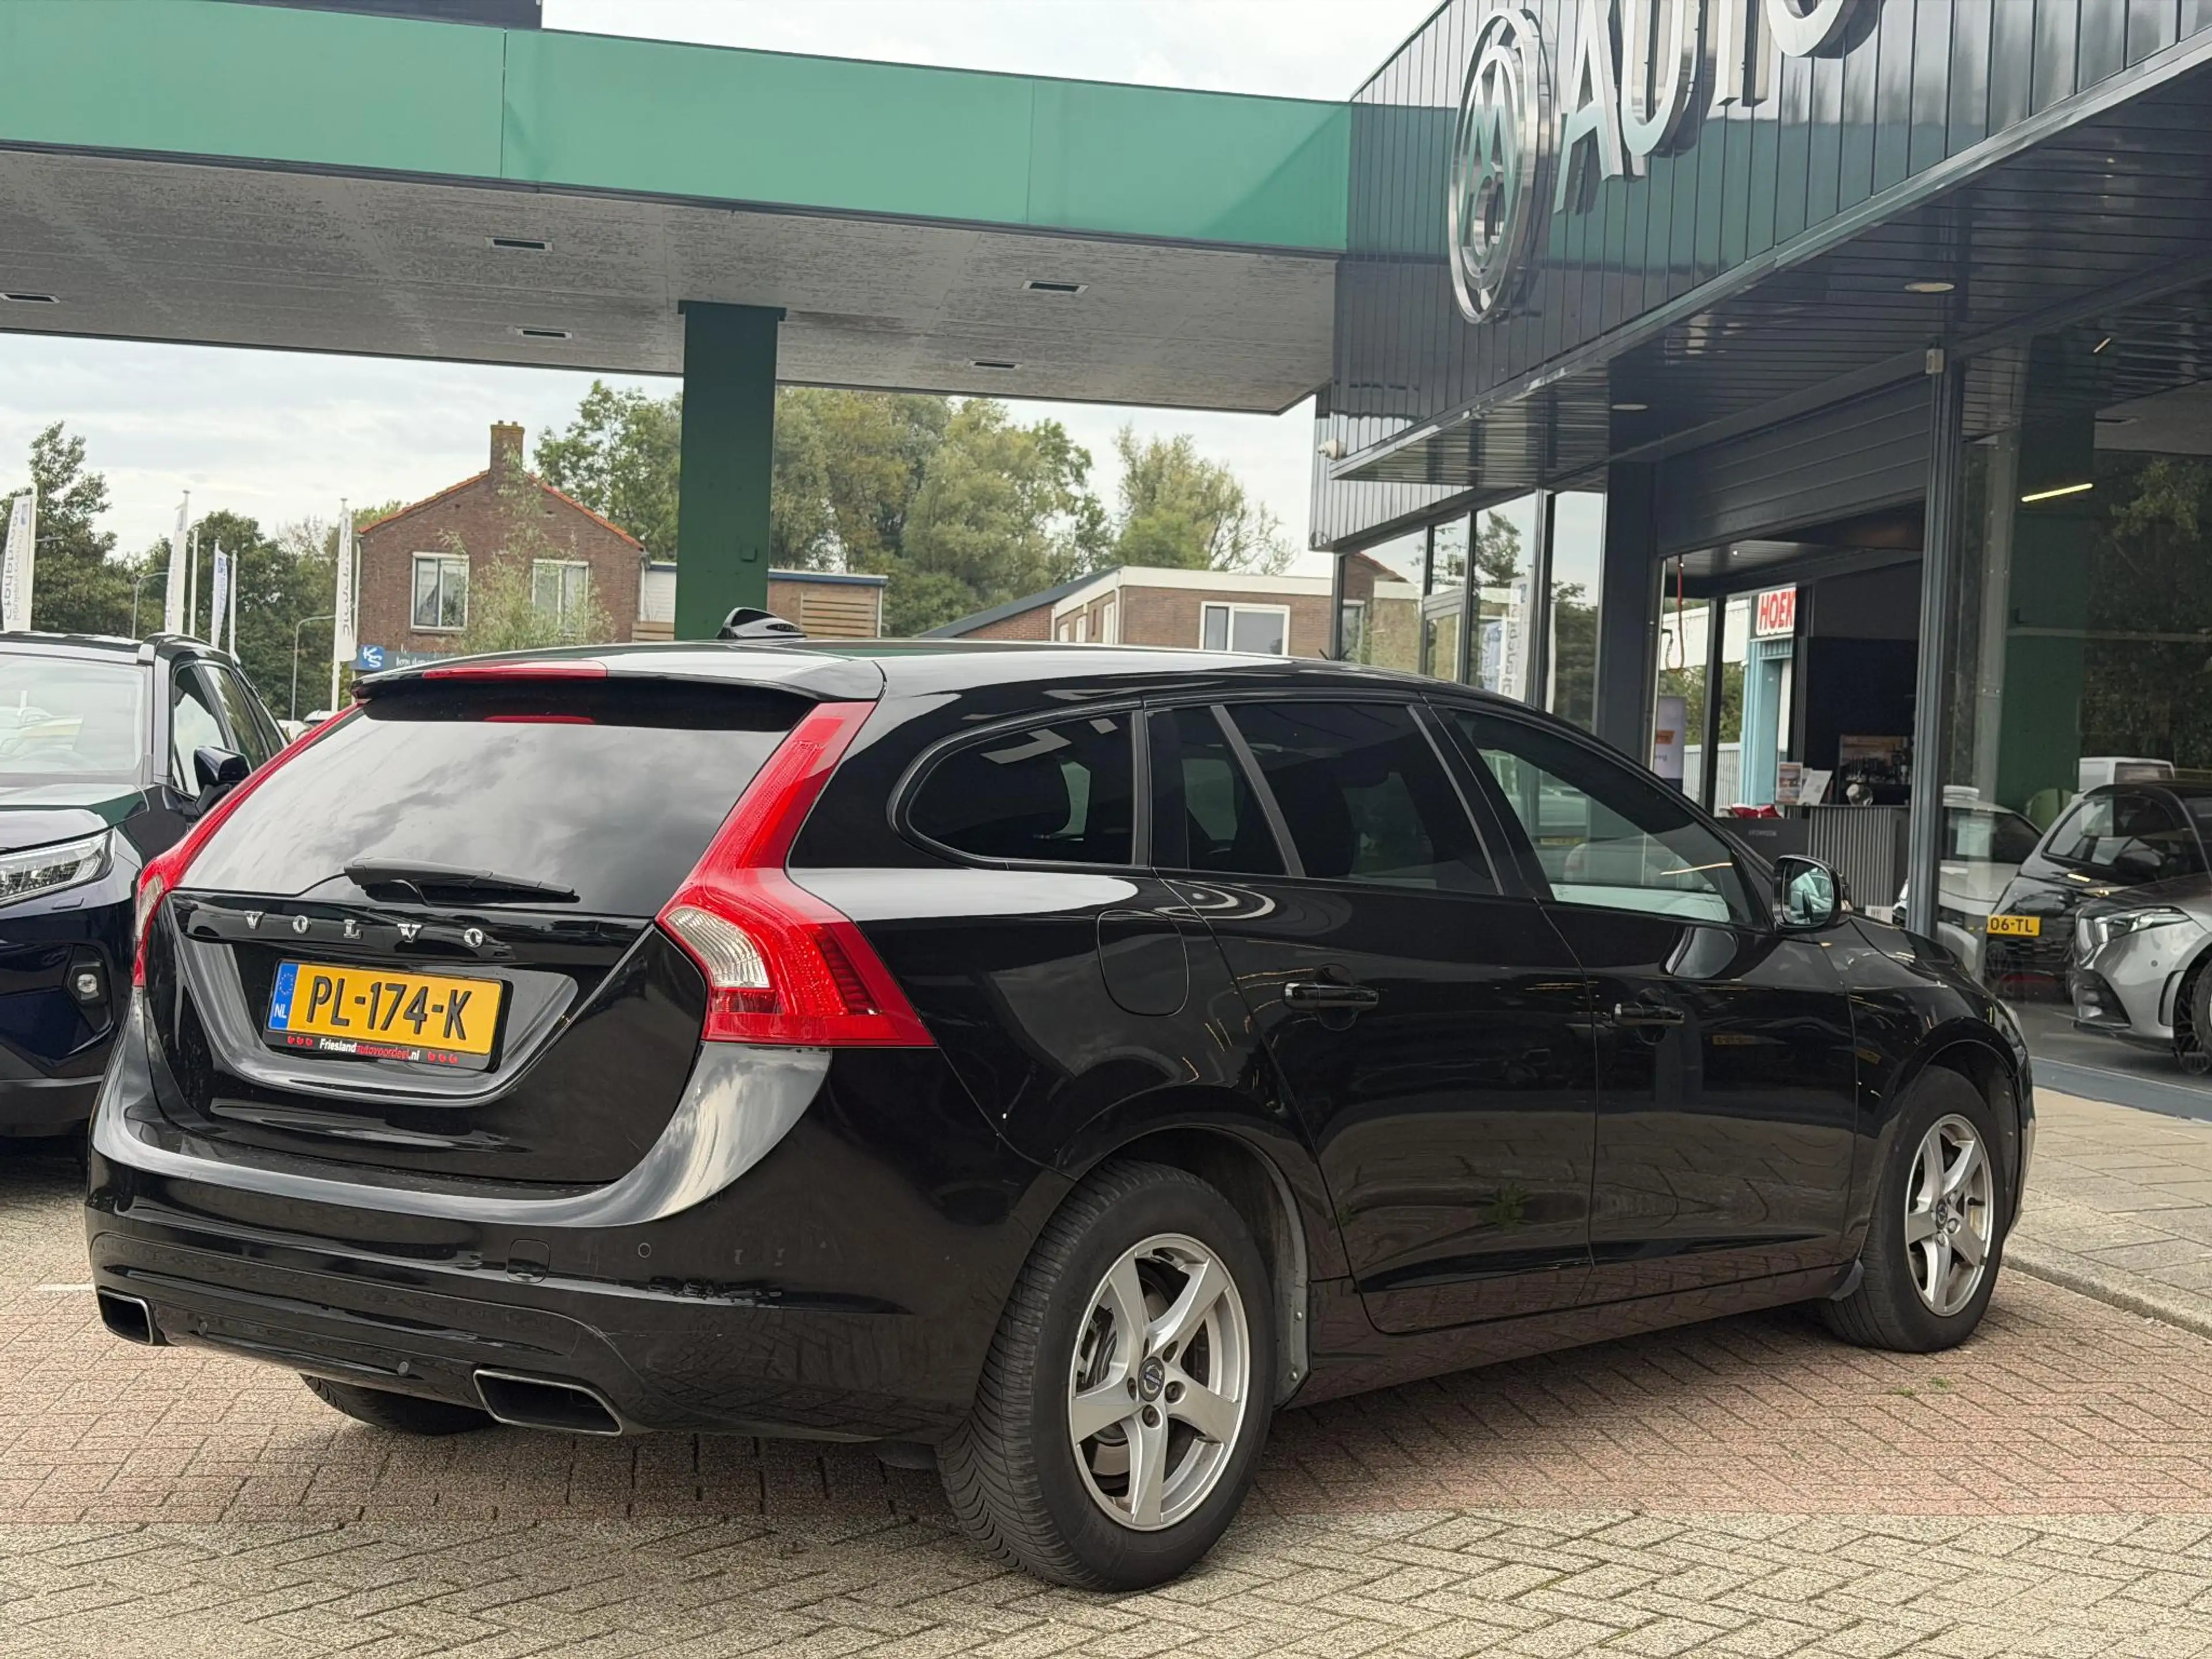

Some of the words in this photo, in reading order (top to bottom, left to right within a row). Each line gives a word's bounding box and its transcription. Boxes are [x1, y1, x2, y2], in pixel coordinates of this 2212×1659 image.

[363, 647, 382, 668] KS
[244, 910, 484, 948] VOLVO
[274, 1003, 287, 1018] NL
[306, 975, 472, 1040] PL-174-K
